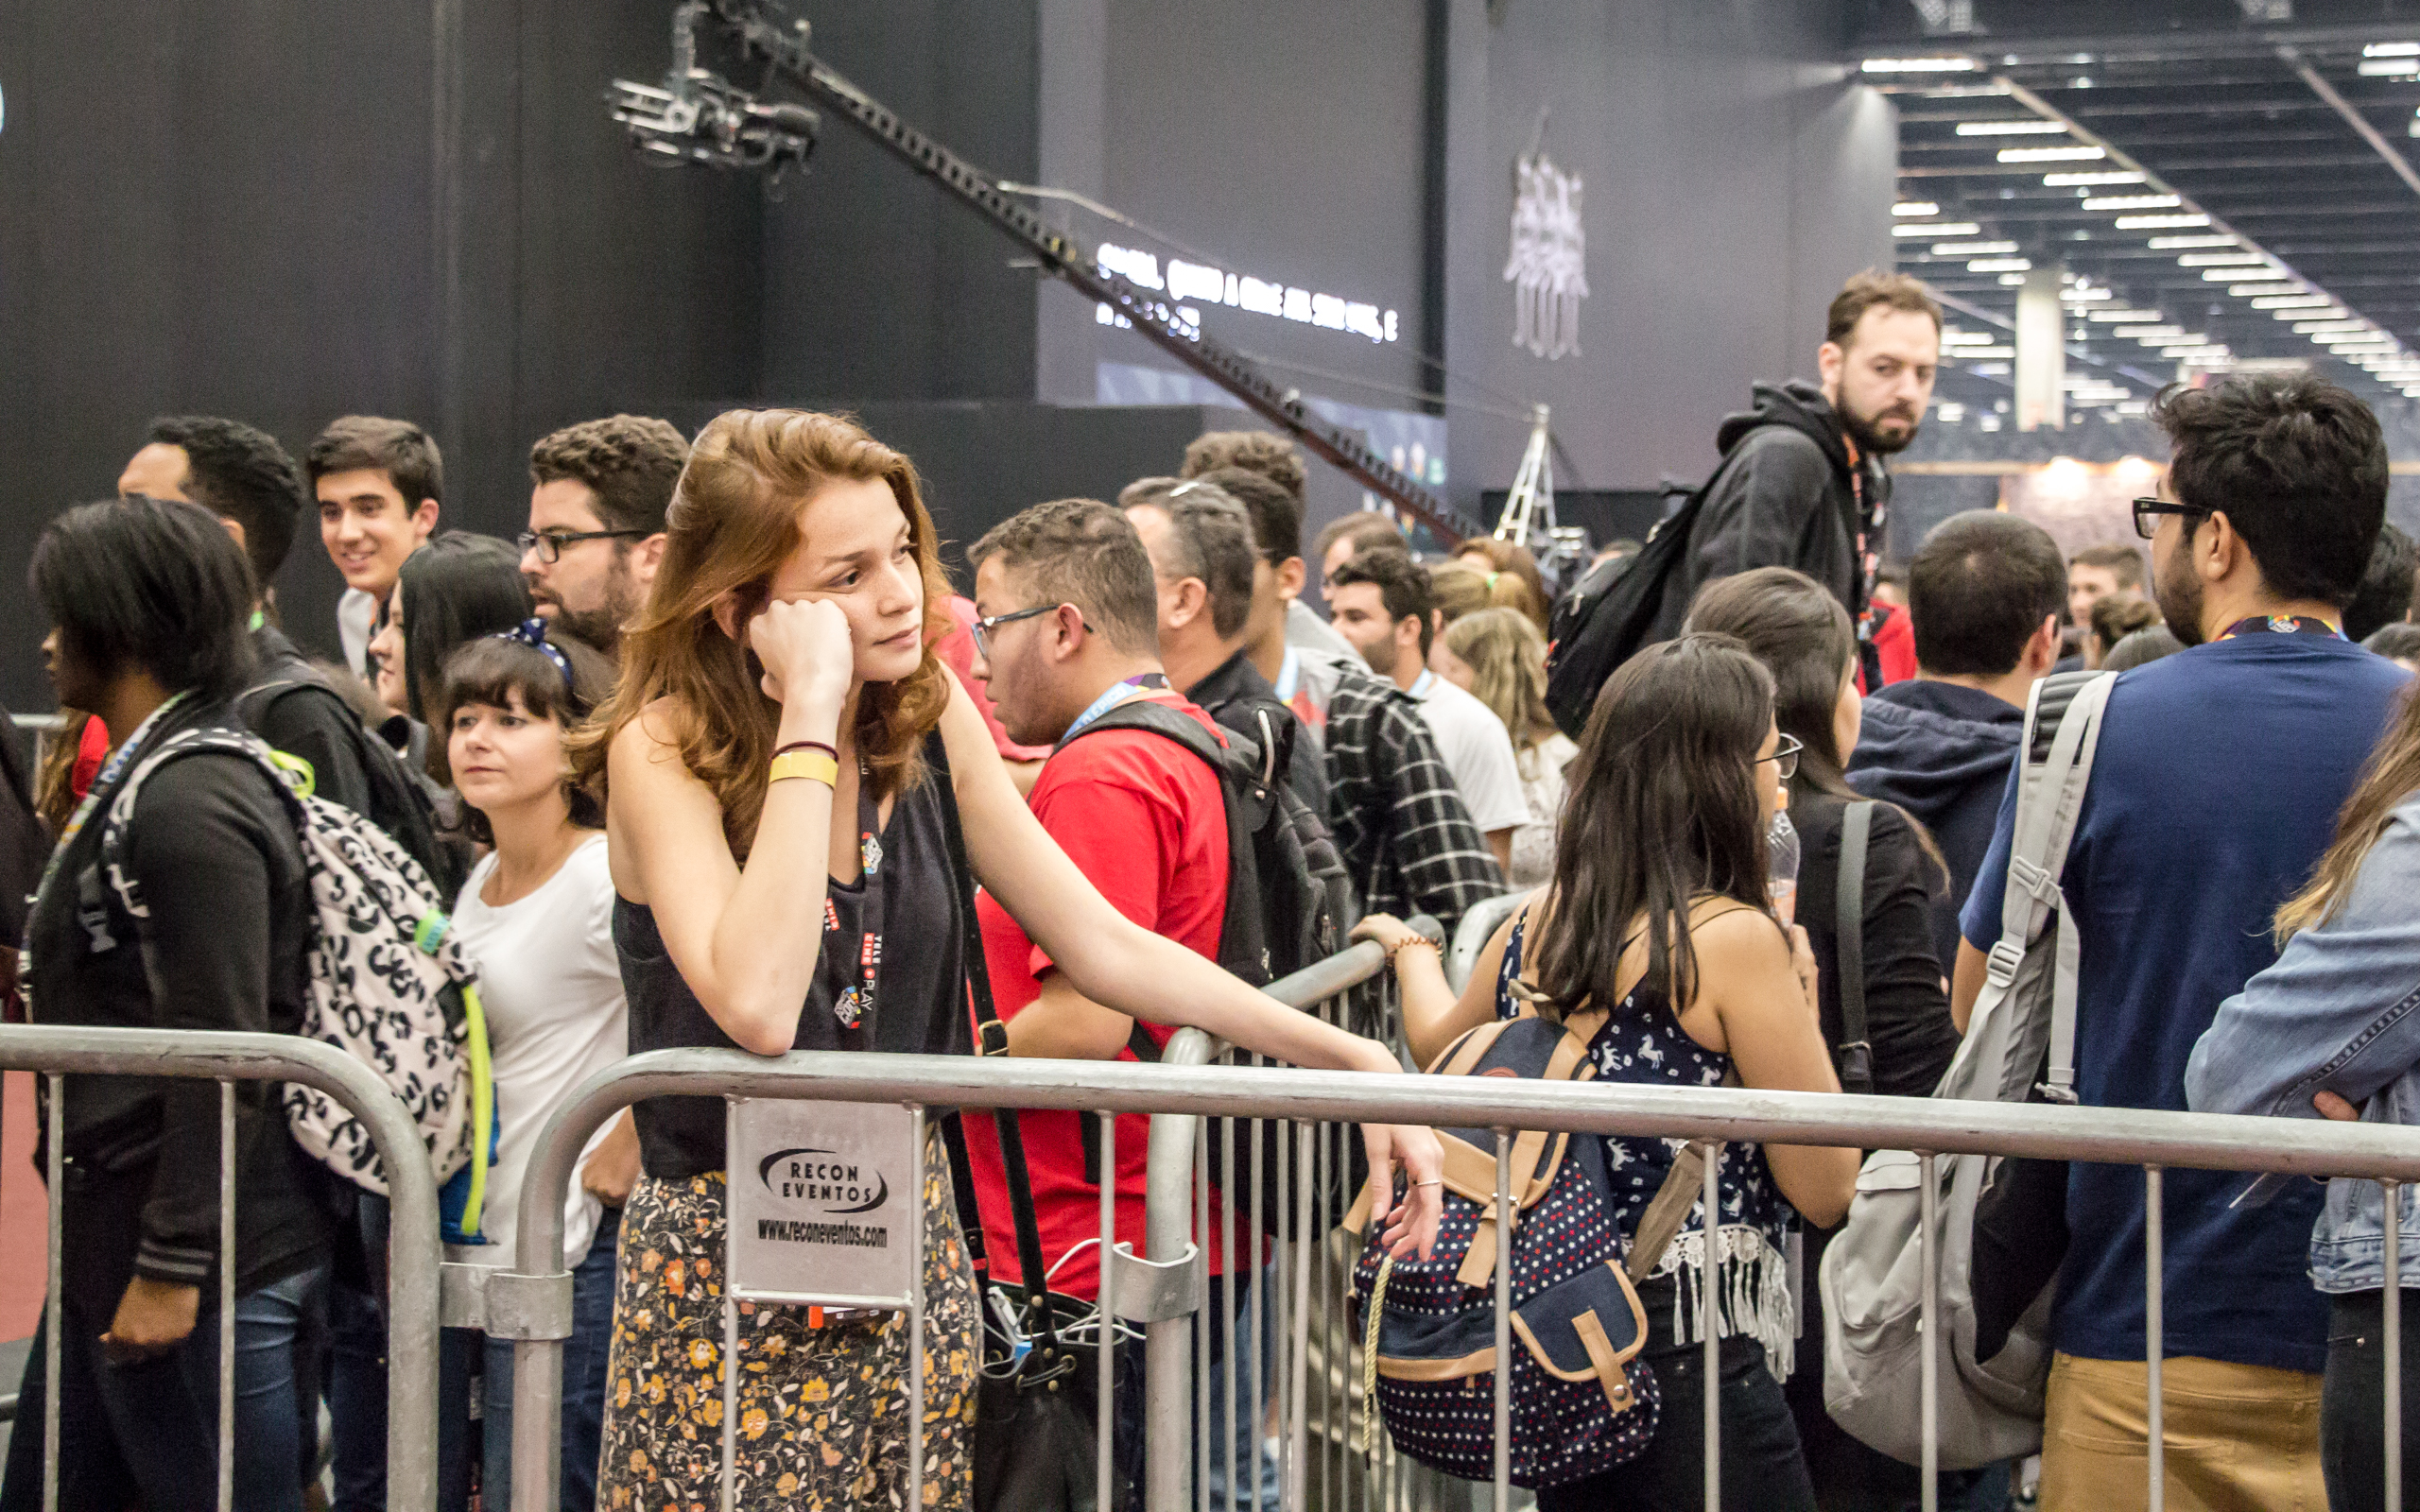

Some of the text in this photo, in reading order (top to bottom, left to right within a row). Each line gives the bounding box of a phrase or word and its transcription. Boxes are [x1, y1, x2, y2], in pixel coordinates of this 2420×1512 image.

[862, 934, 873, 963] CINE
[872, 935, 882, 964] TELE
[860, 979, 875, 1011] PLAY
[790, 1161, 858, 1181] RECON
[783, 1182, 871, 1202] EVENTOS
[758, 1219, 888, 1248] www.reconeventos.com
